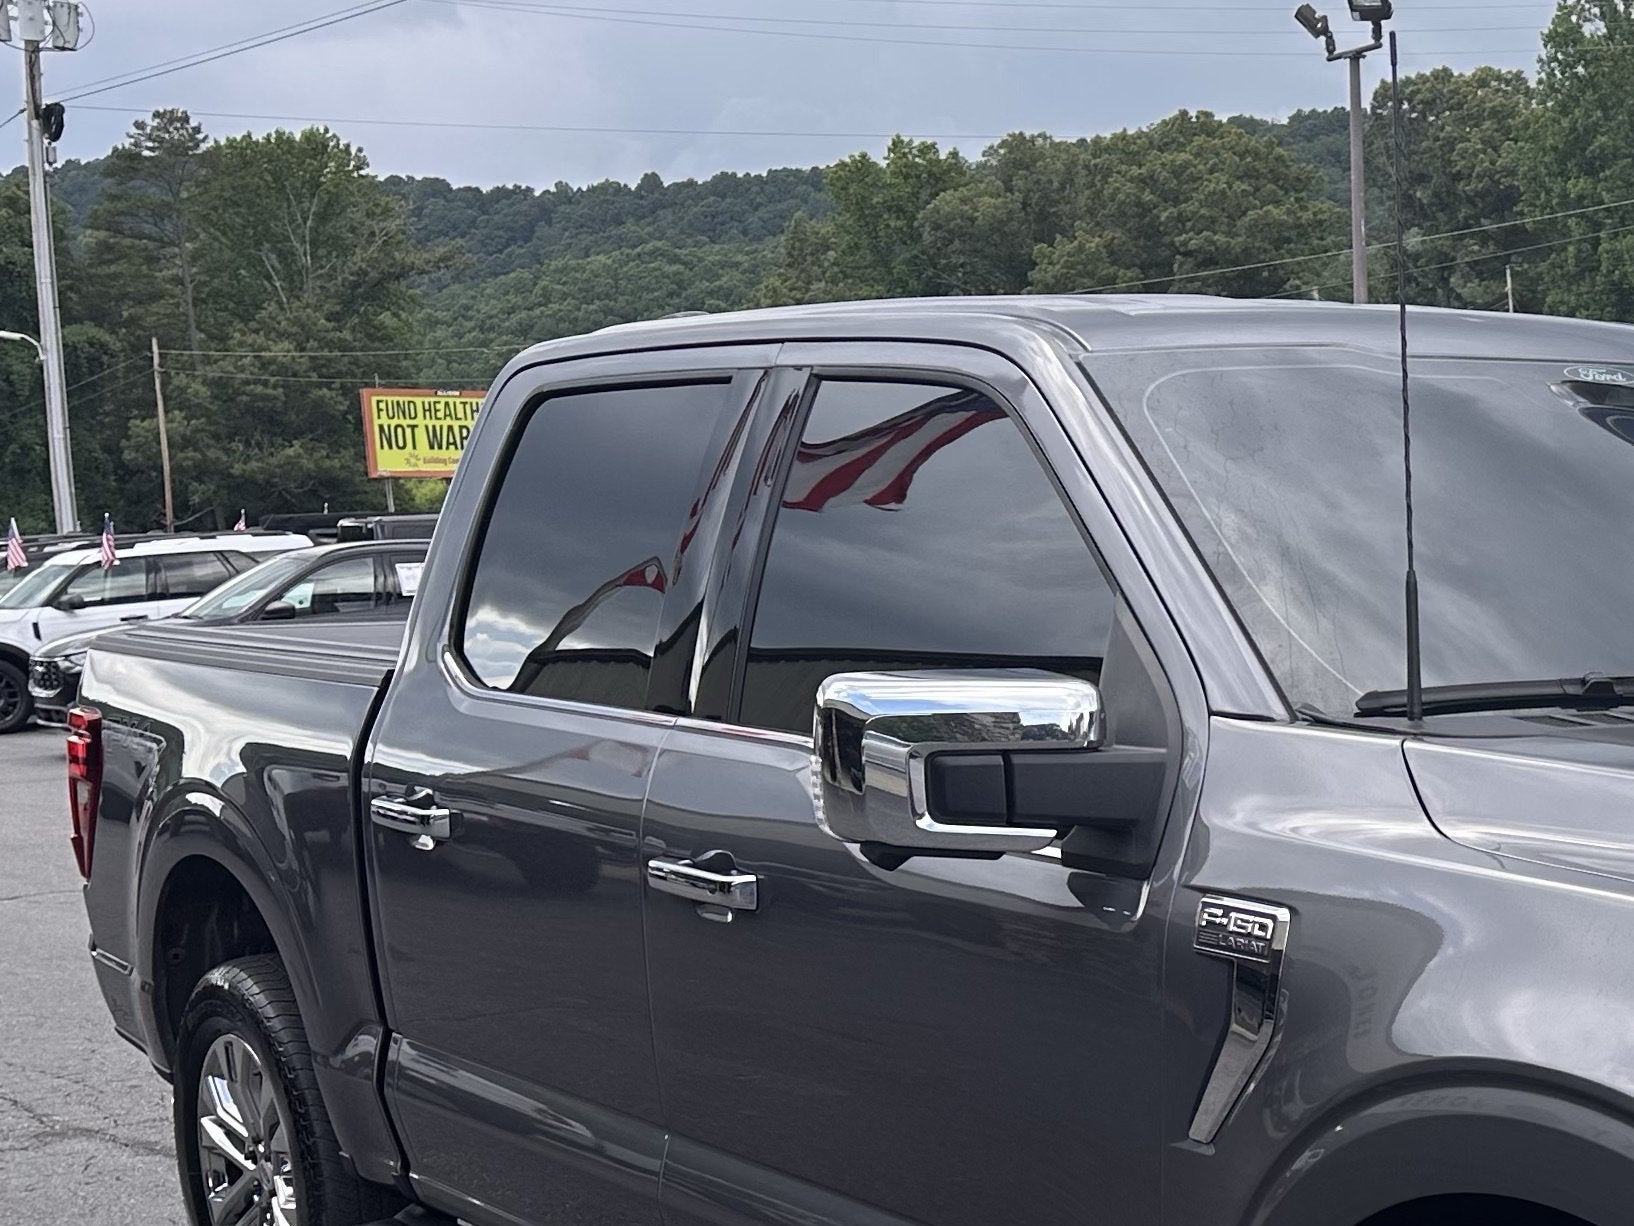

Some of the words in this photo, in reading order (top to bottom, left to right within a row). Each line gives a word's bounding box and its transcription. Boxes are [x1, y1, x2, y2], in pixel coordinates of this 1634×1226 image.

[1578, 367, 1627, 381] Ford
[376, 399, 418, 420] FUND
[422, 400, 484, 421] HEALTH
[377, 423, 419, 450] NOT
[1200, 907, 1275, 940] F-150
[1217, 933, 1266, 954] LARIAT
